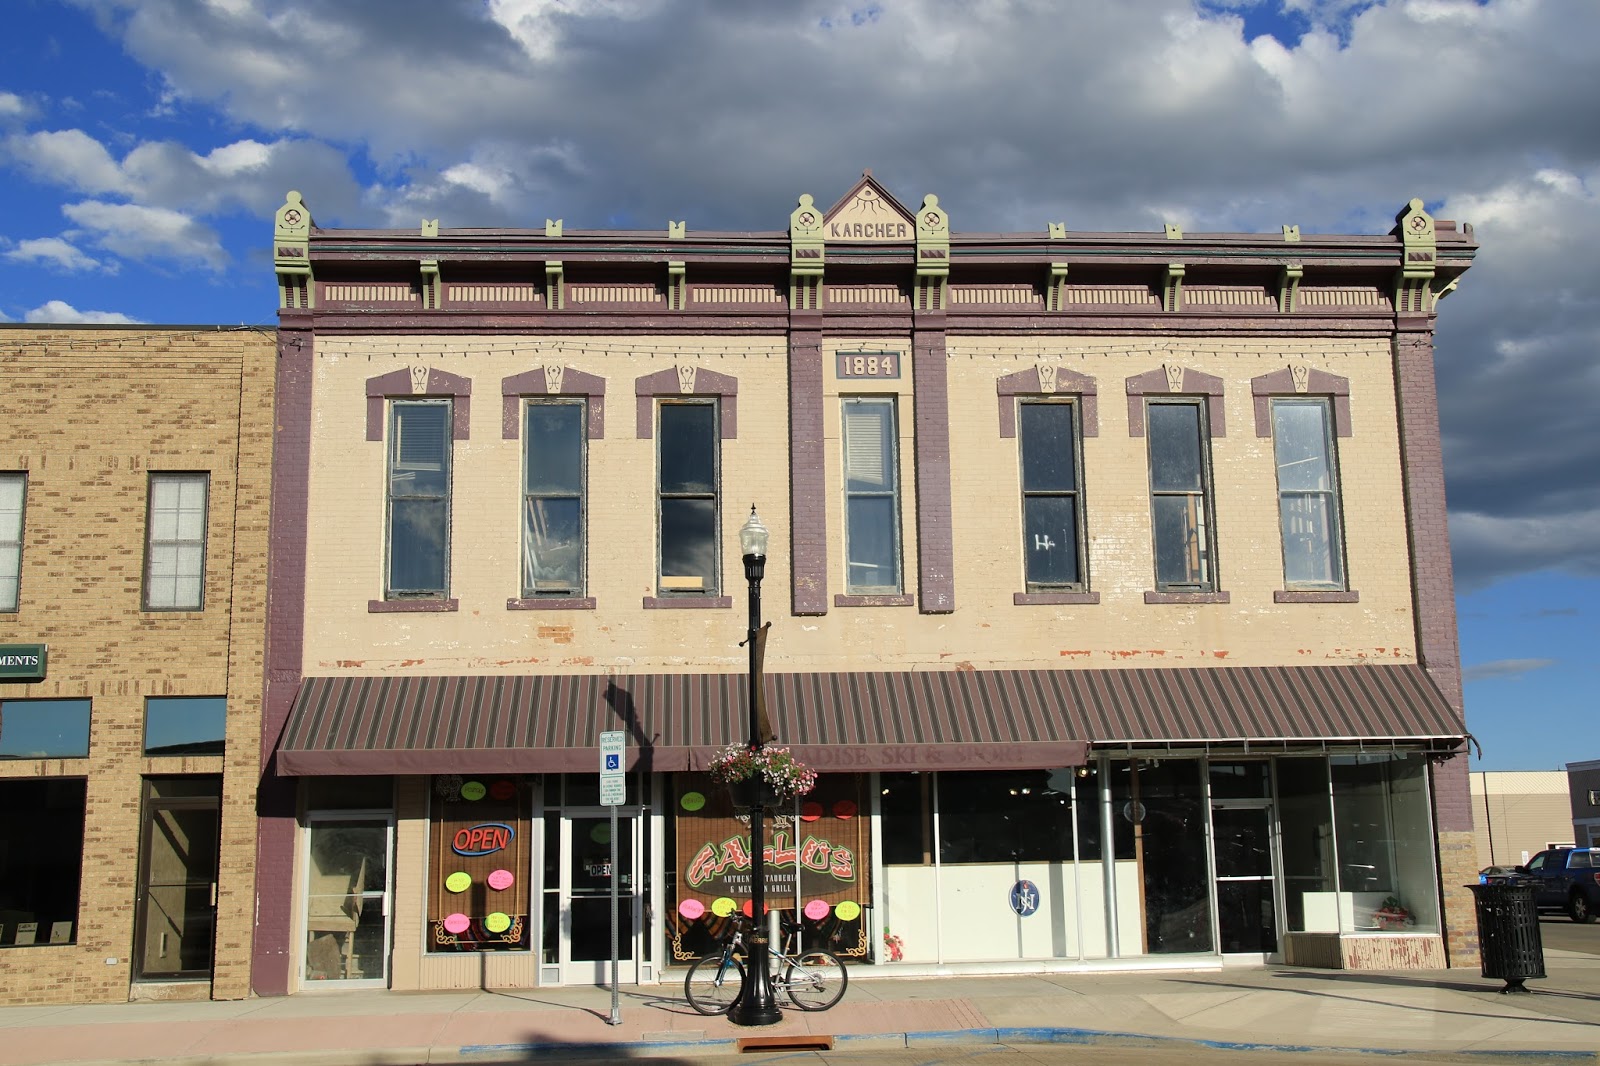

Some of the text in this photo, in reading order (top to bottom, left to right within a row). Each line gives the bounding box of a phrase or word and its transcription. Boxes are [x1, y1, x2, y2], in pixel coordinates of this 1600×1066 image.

[831, 222, 907, 238] KARCHER
[844, 356, 893, 375] 1884
[881, 746, 918, 764] SKI
[454, 828, 509, 850] OPEN
[591, 864, 612, 876] OPEN
[738, 885, 768, 893] MEXN
[771, 884, 792, 893] GRILL
